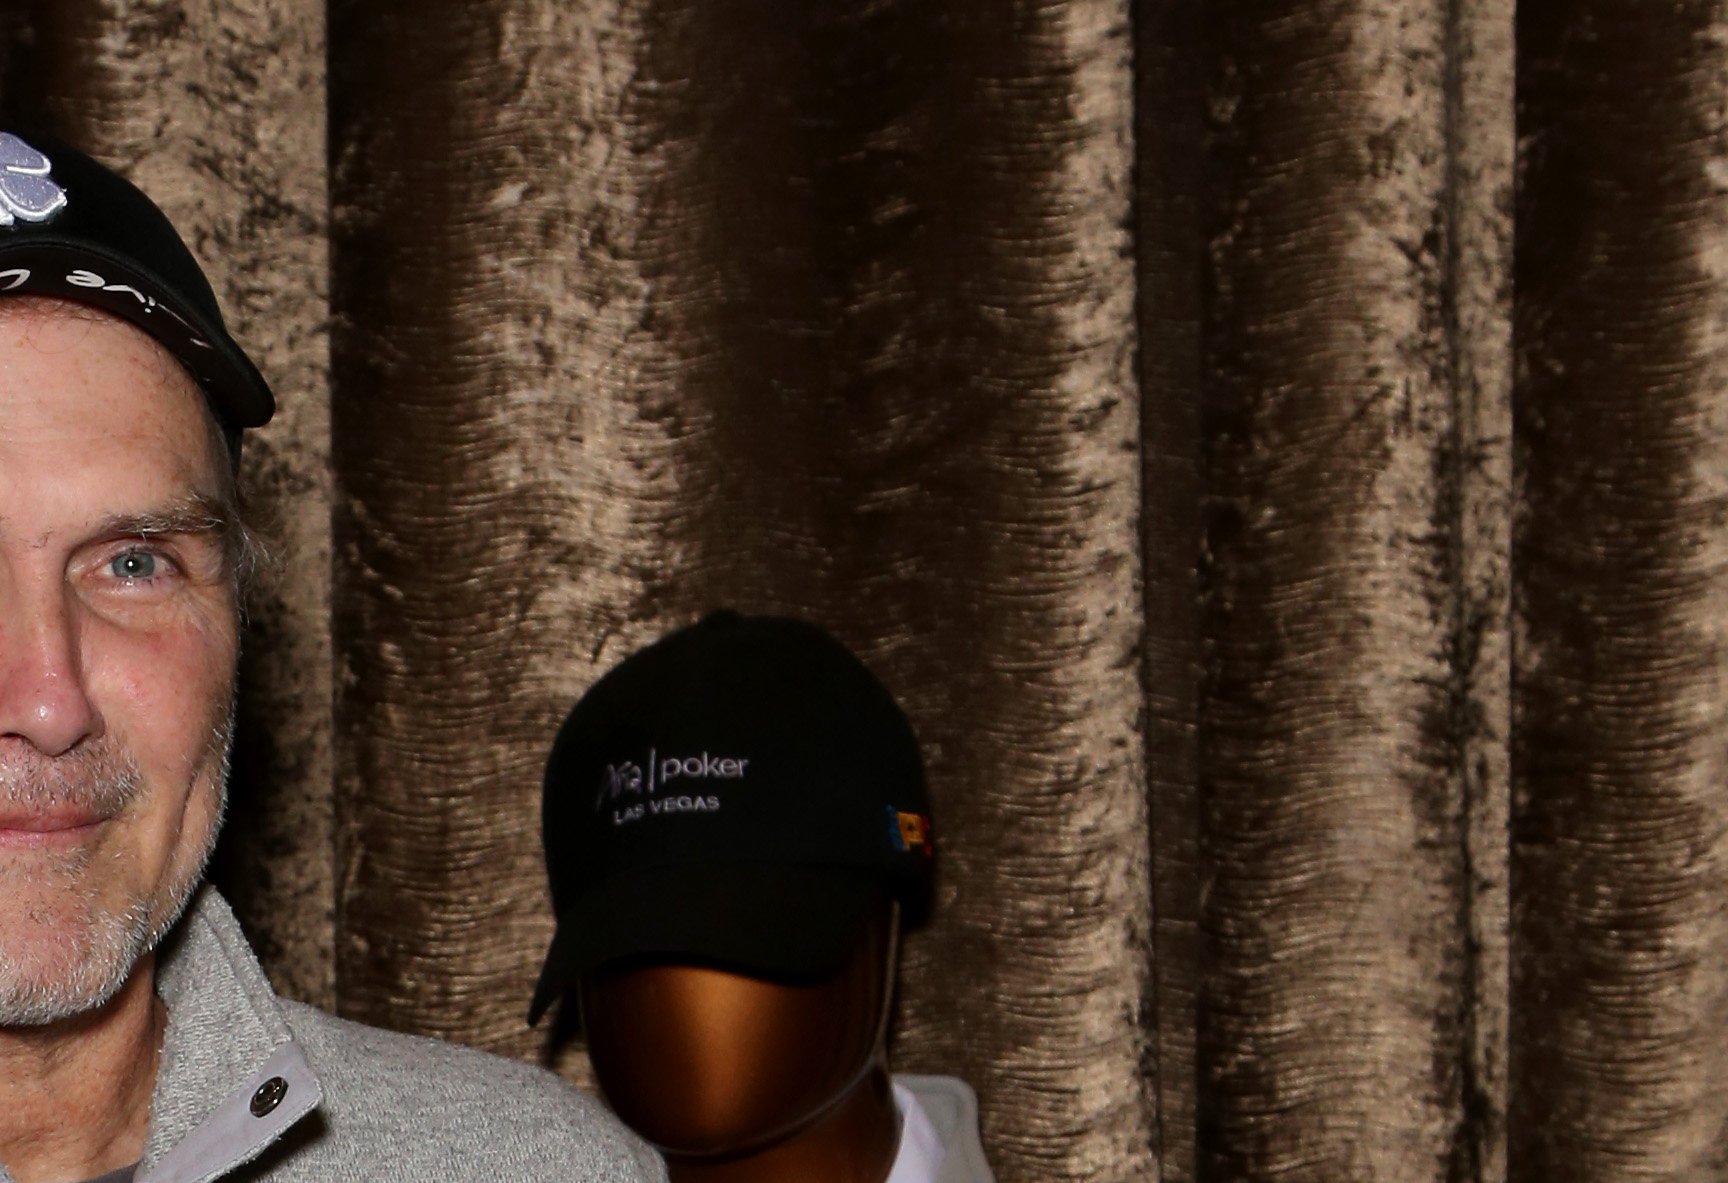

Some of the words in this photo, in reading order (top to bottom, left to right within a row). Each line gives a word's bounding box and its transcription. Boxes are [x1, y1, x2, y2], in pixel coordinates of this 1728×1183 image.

[660, 750, 750, 784] poker
[613, 802, 646, 826] LAS
[649, 794, 721, 815] VEGAS
